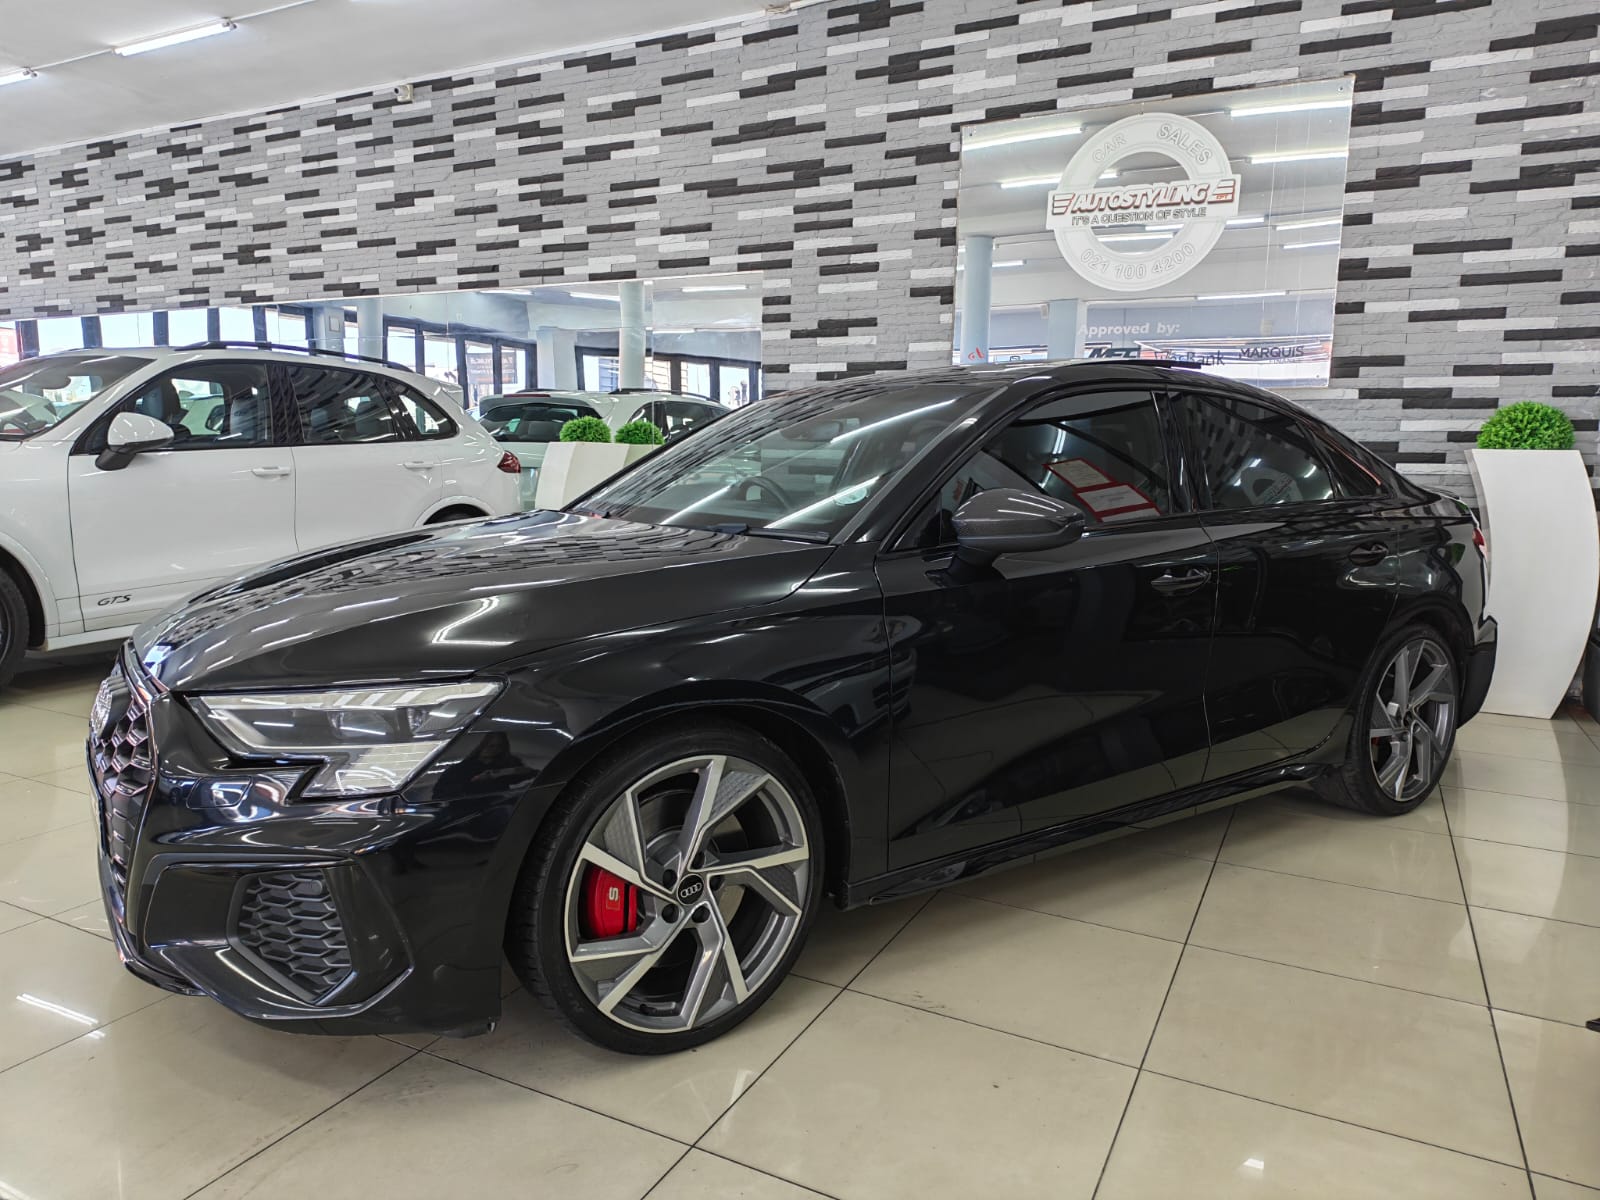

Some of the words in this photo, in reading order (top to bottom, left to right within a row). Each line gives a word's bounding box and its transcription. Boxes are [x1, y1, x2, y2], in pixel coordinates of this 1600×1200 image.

[1093, 134, 1127, 161] CAR
[1158, 123, 1212, 164] SALES
[1071, 183, 1209, 213] AUTOSTYLING
[1071, 215, 1090, 226] IT'S
[1091, 214, 1100, 225] A
[1101, 210, 1154, 224] QUESTION
[1156, 209, 1171, 220] OF
[1173, 207, 1207, 218] STYLE
[1080, 248, 1110, 272] 021
[1113, 263, 1146, 280] 100
[1151, 242, 1195, 273] 4200
[1079, 323, 1150, 338] Approved
[1157, 322, 1180, 336] by:
[1239, 345, 1304, 360] MARQUIS
[97, 594, 132, 606] GTS
[608, 886, 619, 902] S
